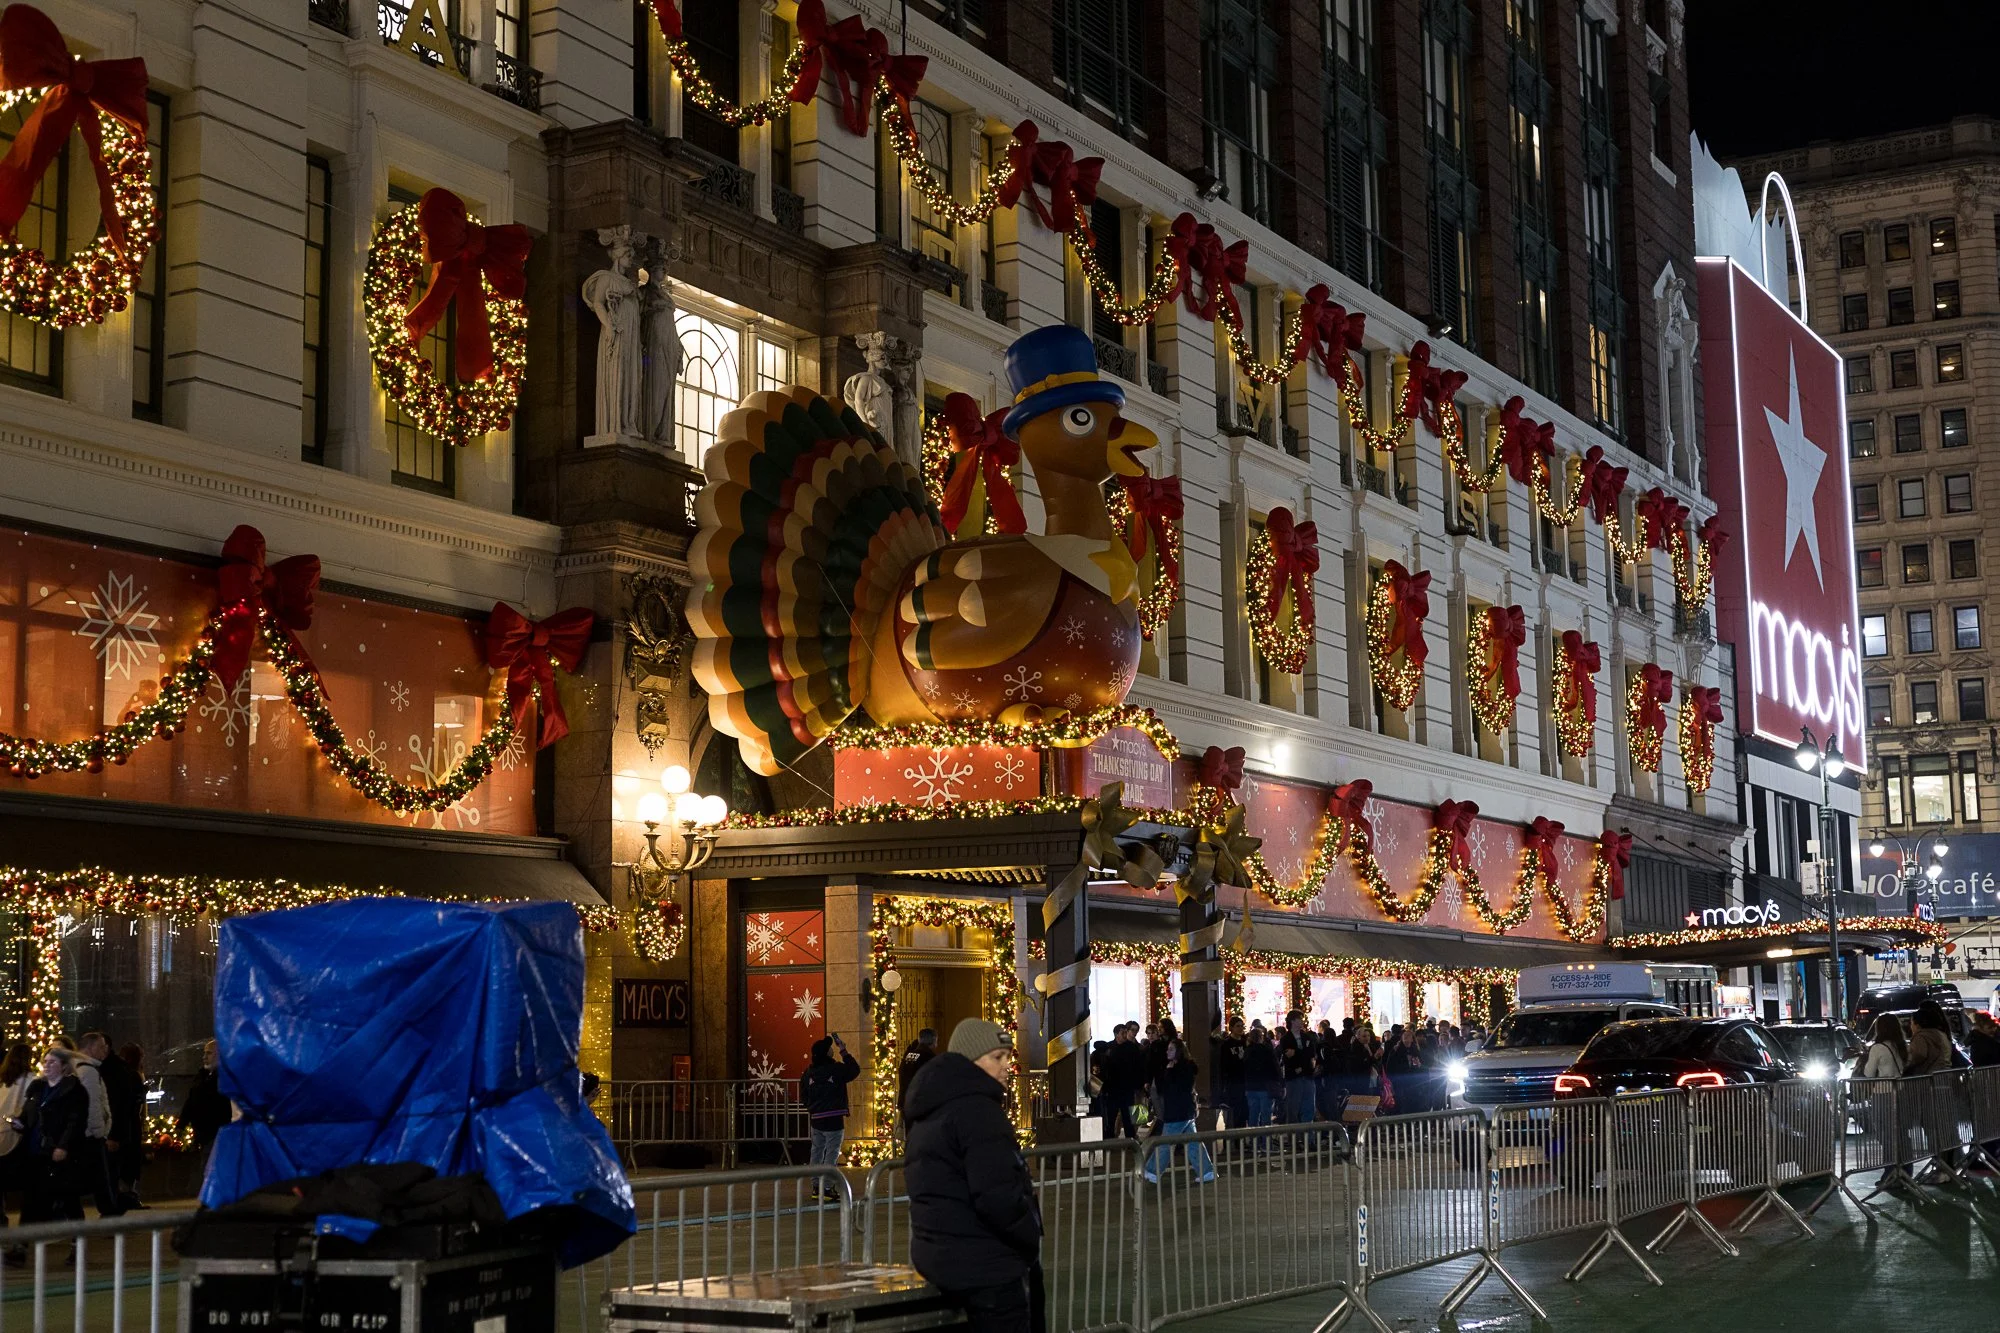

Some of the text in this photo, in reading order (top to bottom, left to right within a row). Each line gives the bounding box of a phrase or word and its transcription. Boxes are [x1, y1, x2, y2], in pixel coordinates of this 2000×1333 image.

[1752, 601, 1861, 752] macy's
[1093, 753, 1164, 783] THANKSGIVING DAY
[1939, 872, 1995, 894] café
[1702, 899, 1781, 926] macy's
[1550, 973, 1612, 982] ACCESS-A-RIDE
[1550, 980, 1611, 990] 1-877-337-2017
[622, 984, 686, 1021] MACY'S
[1490, 1171, 1499, 1221] NYPD
[1358, 1207, 1368, 1264] NYPD
[208, 1310, 230, 1326] DO
[320, 1311, 341, 1328] OR
[352, 1312, 389, 1329] FLIP
